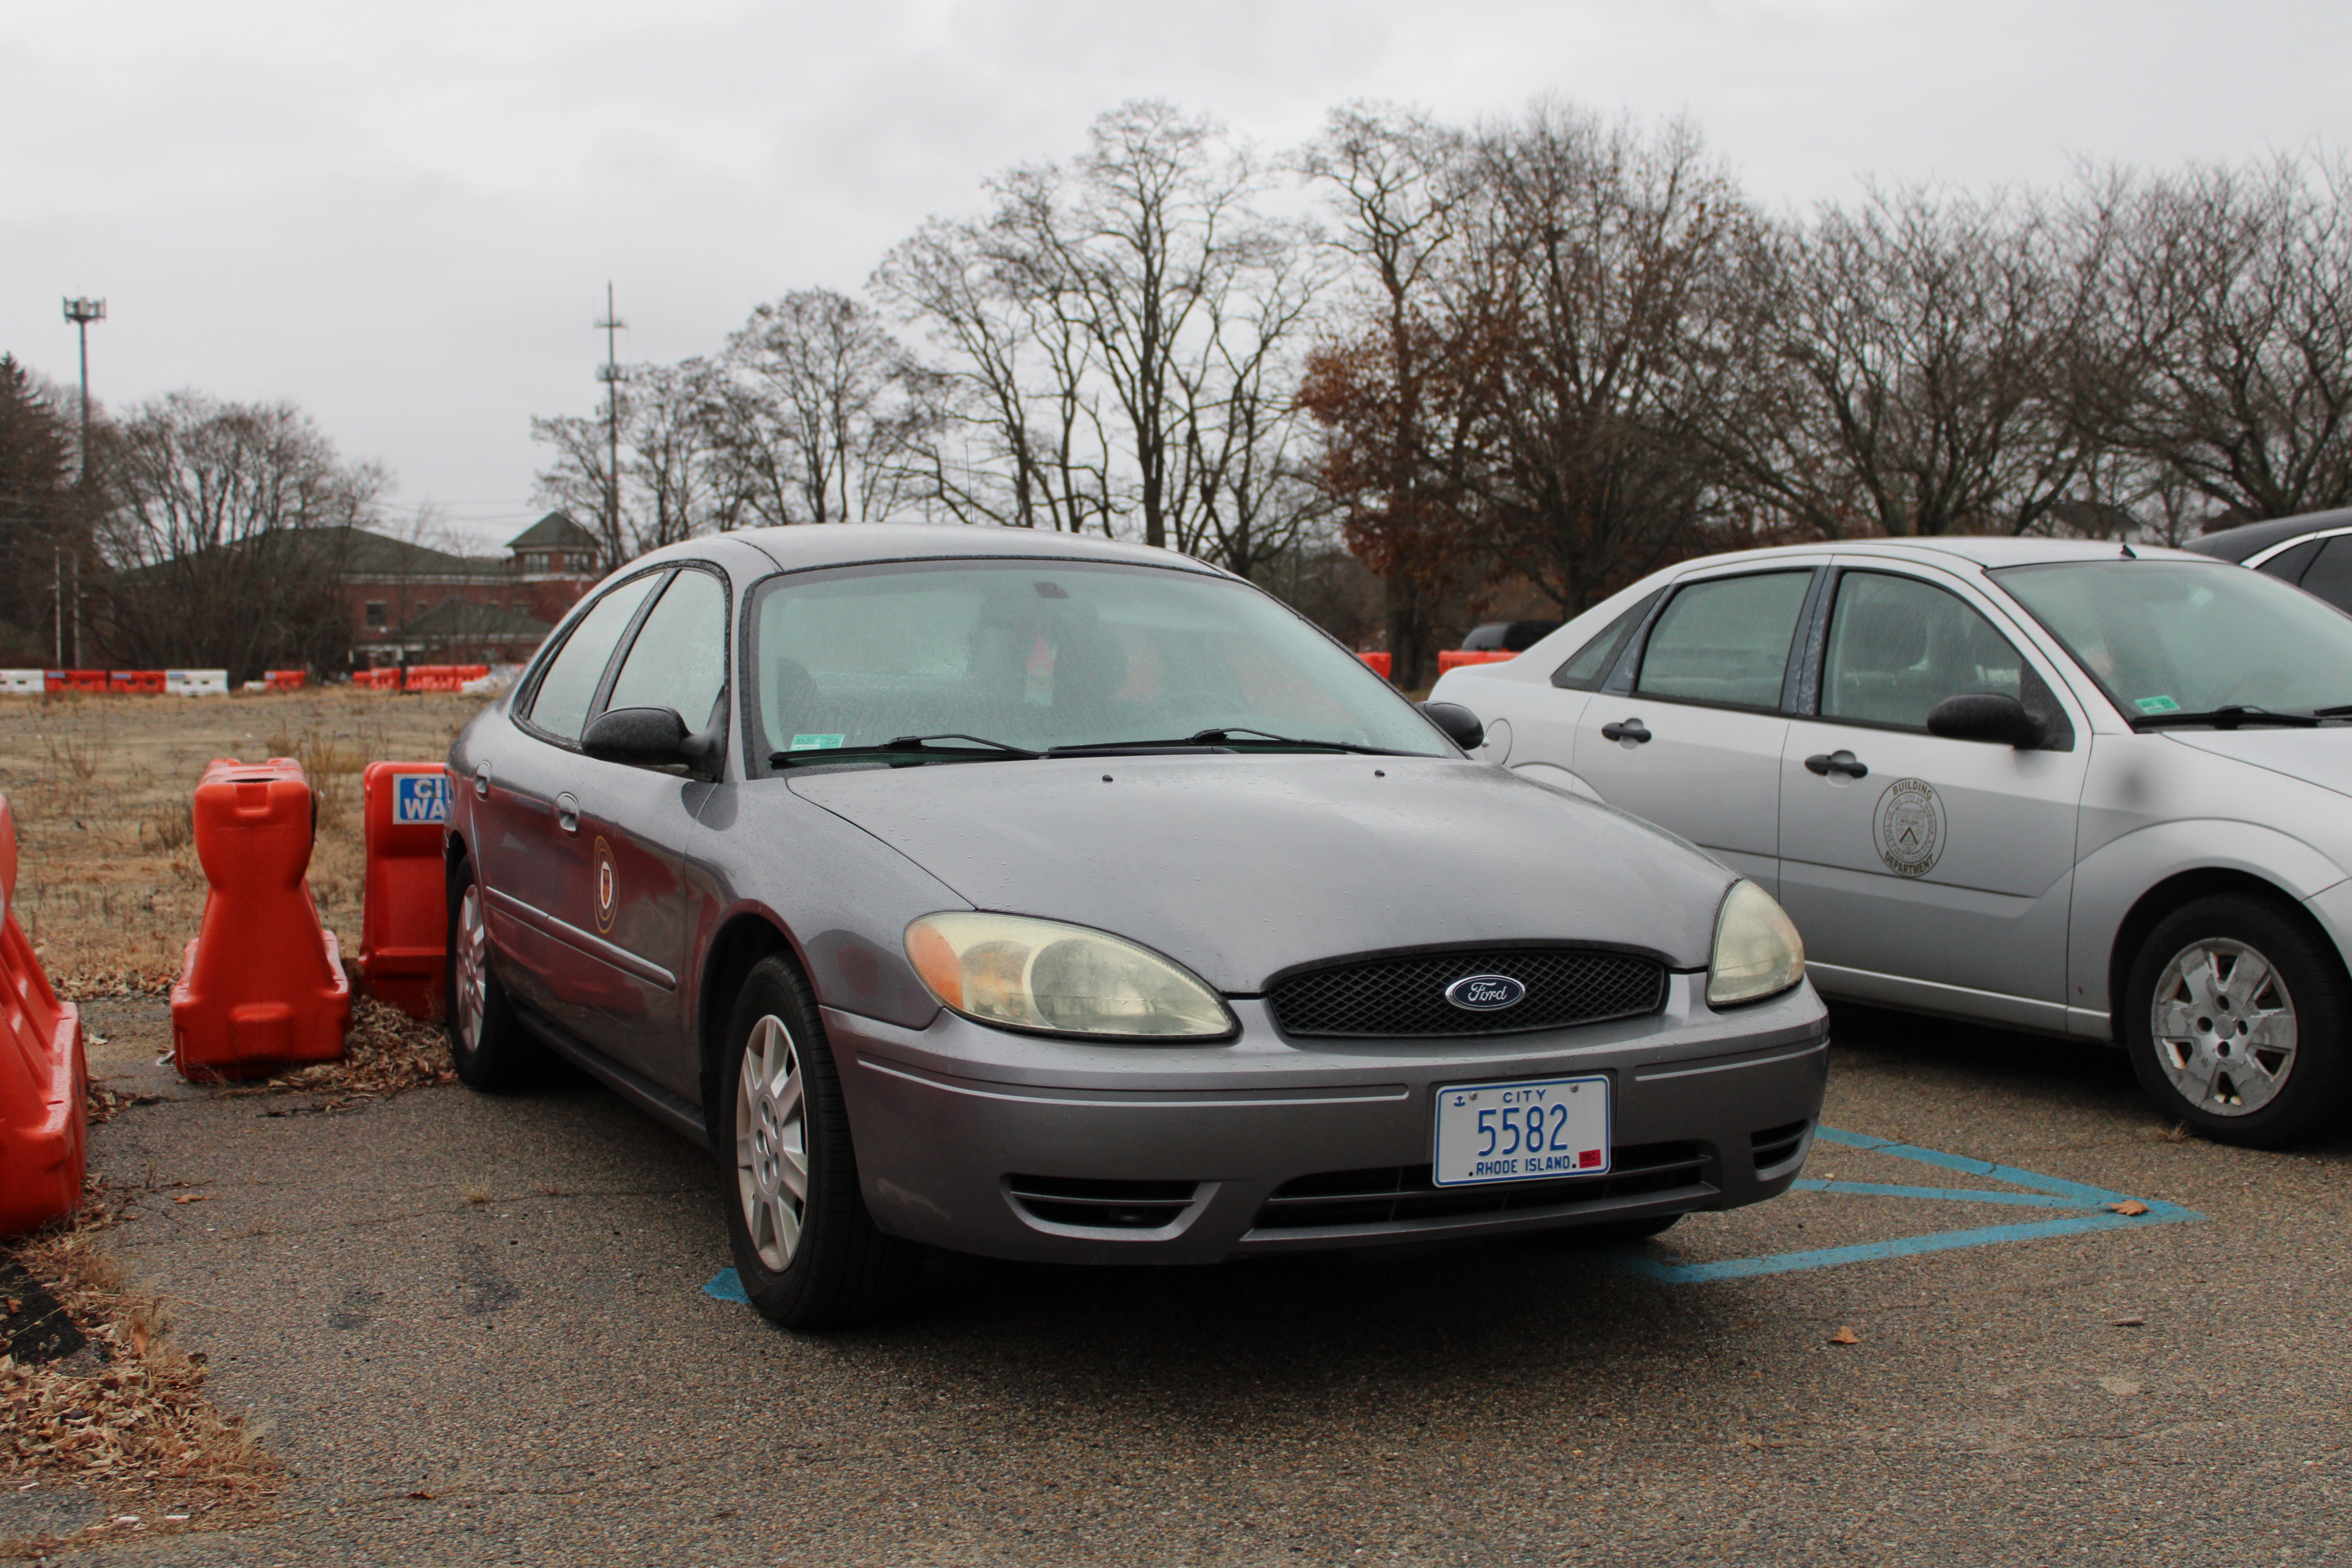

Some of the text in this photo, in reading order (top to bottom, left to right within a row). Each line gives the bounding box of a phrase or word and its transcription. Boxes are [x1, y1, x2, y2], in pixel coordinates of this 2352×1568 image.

[414, 779, 442, 799] CI
[1892, 780, 1933, 800] BUILDING
[1885, 850, 1933, 875] DEPARTMENT
[1468, 982, 1508, 1002] Ford
[1503, 1089, 1546, 1103] CITY
[1477, 1103, 1568, 1156] 5582
[1477, 1155, 1570, 1175] RHODE ISLAND
[1581, 1152, 1596, 1161] DEC
